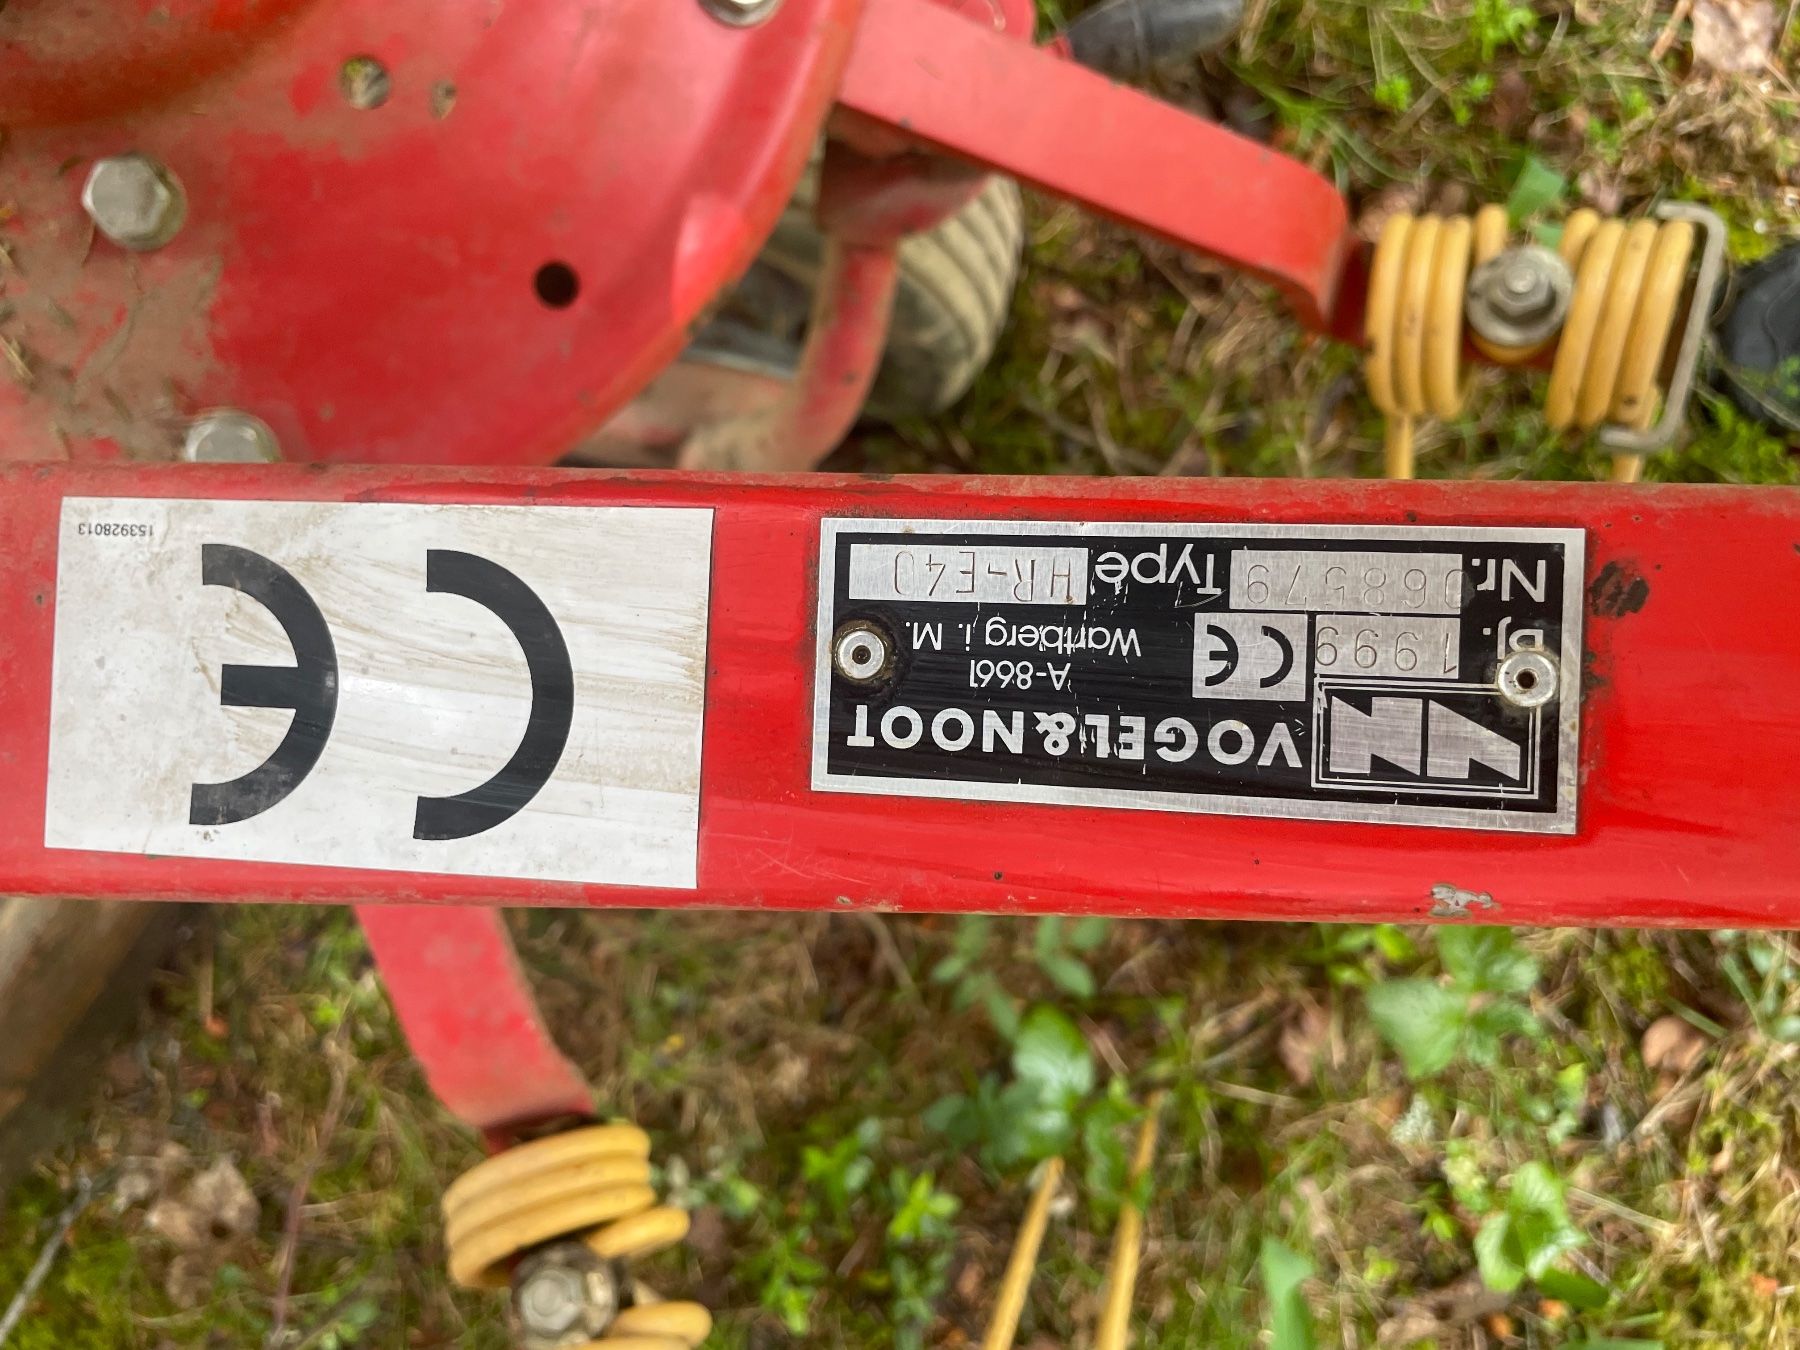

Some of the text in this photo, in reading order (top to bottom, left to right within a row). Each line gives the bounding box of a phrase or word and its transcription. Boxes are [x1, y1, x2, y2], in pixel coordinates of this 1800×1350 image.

[78, 523, 153, 537] 153928013
[1095, 543, 1222, 595] Type
[1471, 558, 1546, 603] Nr.
[905, 622, 943, 651] M.
[985, 616, 1142, 657] Wartberg
[1205, 624, 1294, 689] CE
[1315, 626, 1458, 674] 1999
[189, 543, 574, 840] CE
[970, 659, 1071, 691] A-8661
[847, 704, 1303, 768] VOGEL&NOOT
